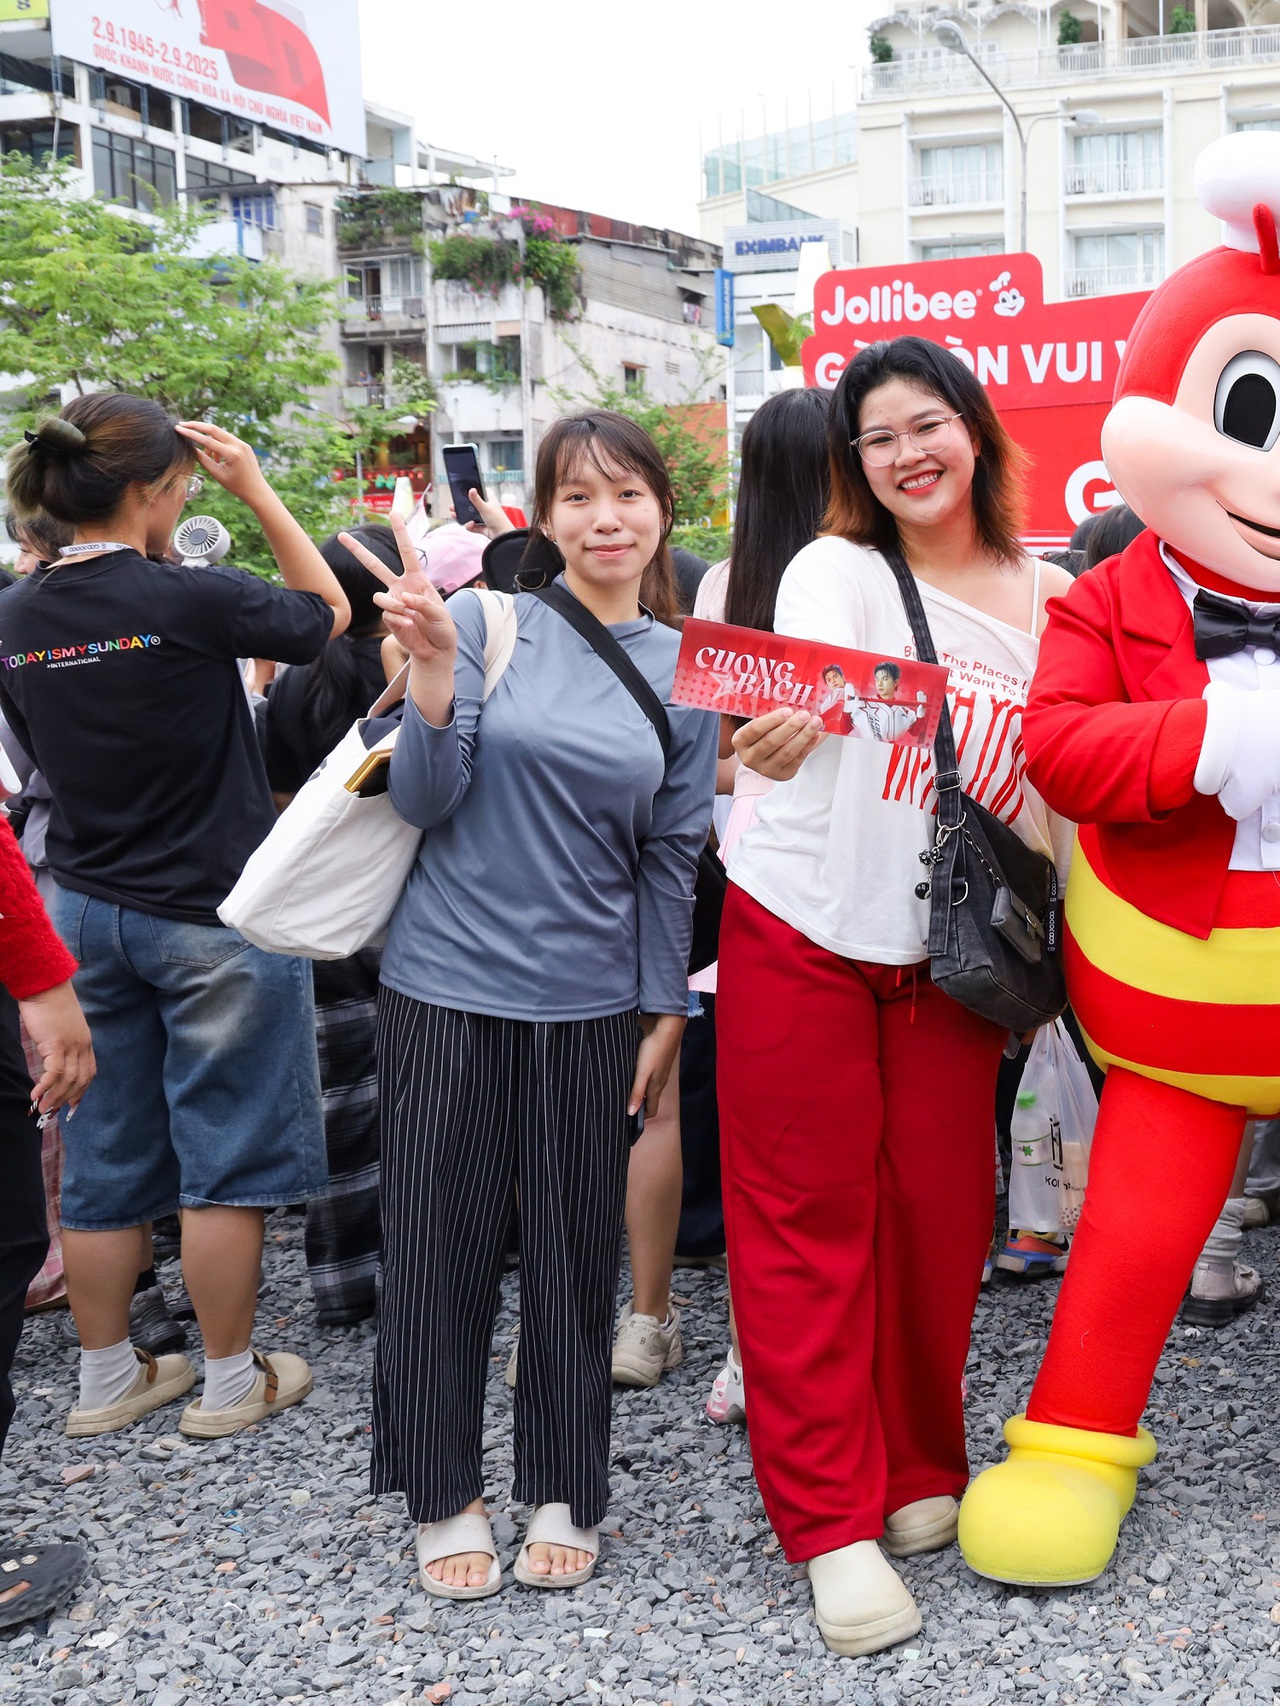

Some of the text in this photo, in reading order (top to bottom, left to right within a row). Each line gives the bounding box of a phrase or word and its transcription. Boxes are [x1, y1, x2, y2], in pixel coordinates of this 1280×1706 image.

[92, 15, 219, 80] 2.9.1945-2.9.2025
[821, 279, 978, 326] Jollibee
[1021, 341, 1103, 384] VUI
[694, 646, 797, 682] CUONG
[942, 653, 968, 668] The
[972, 661, 1019, 686] Places
[734, 672, 816, 707] BACH
[960, 671, 996, 690] Want
[1000, 683, 1017, 697] To
